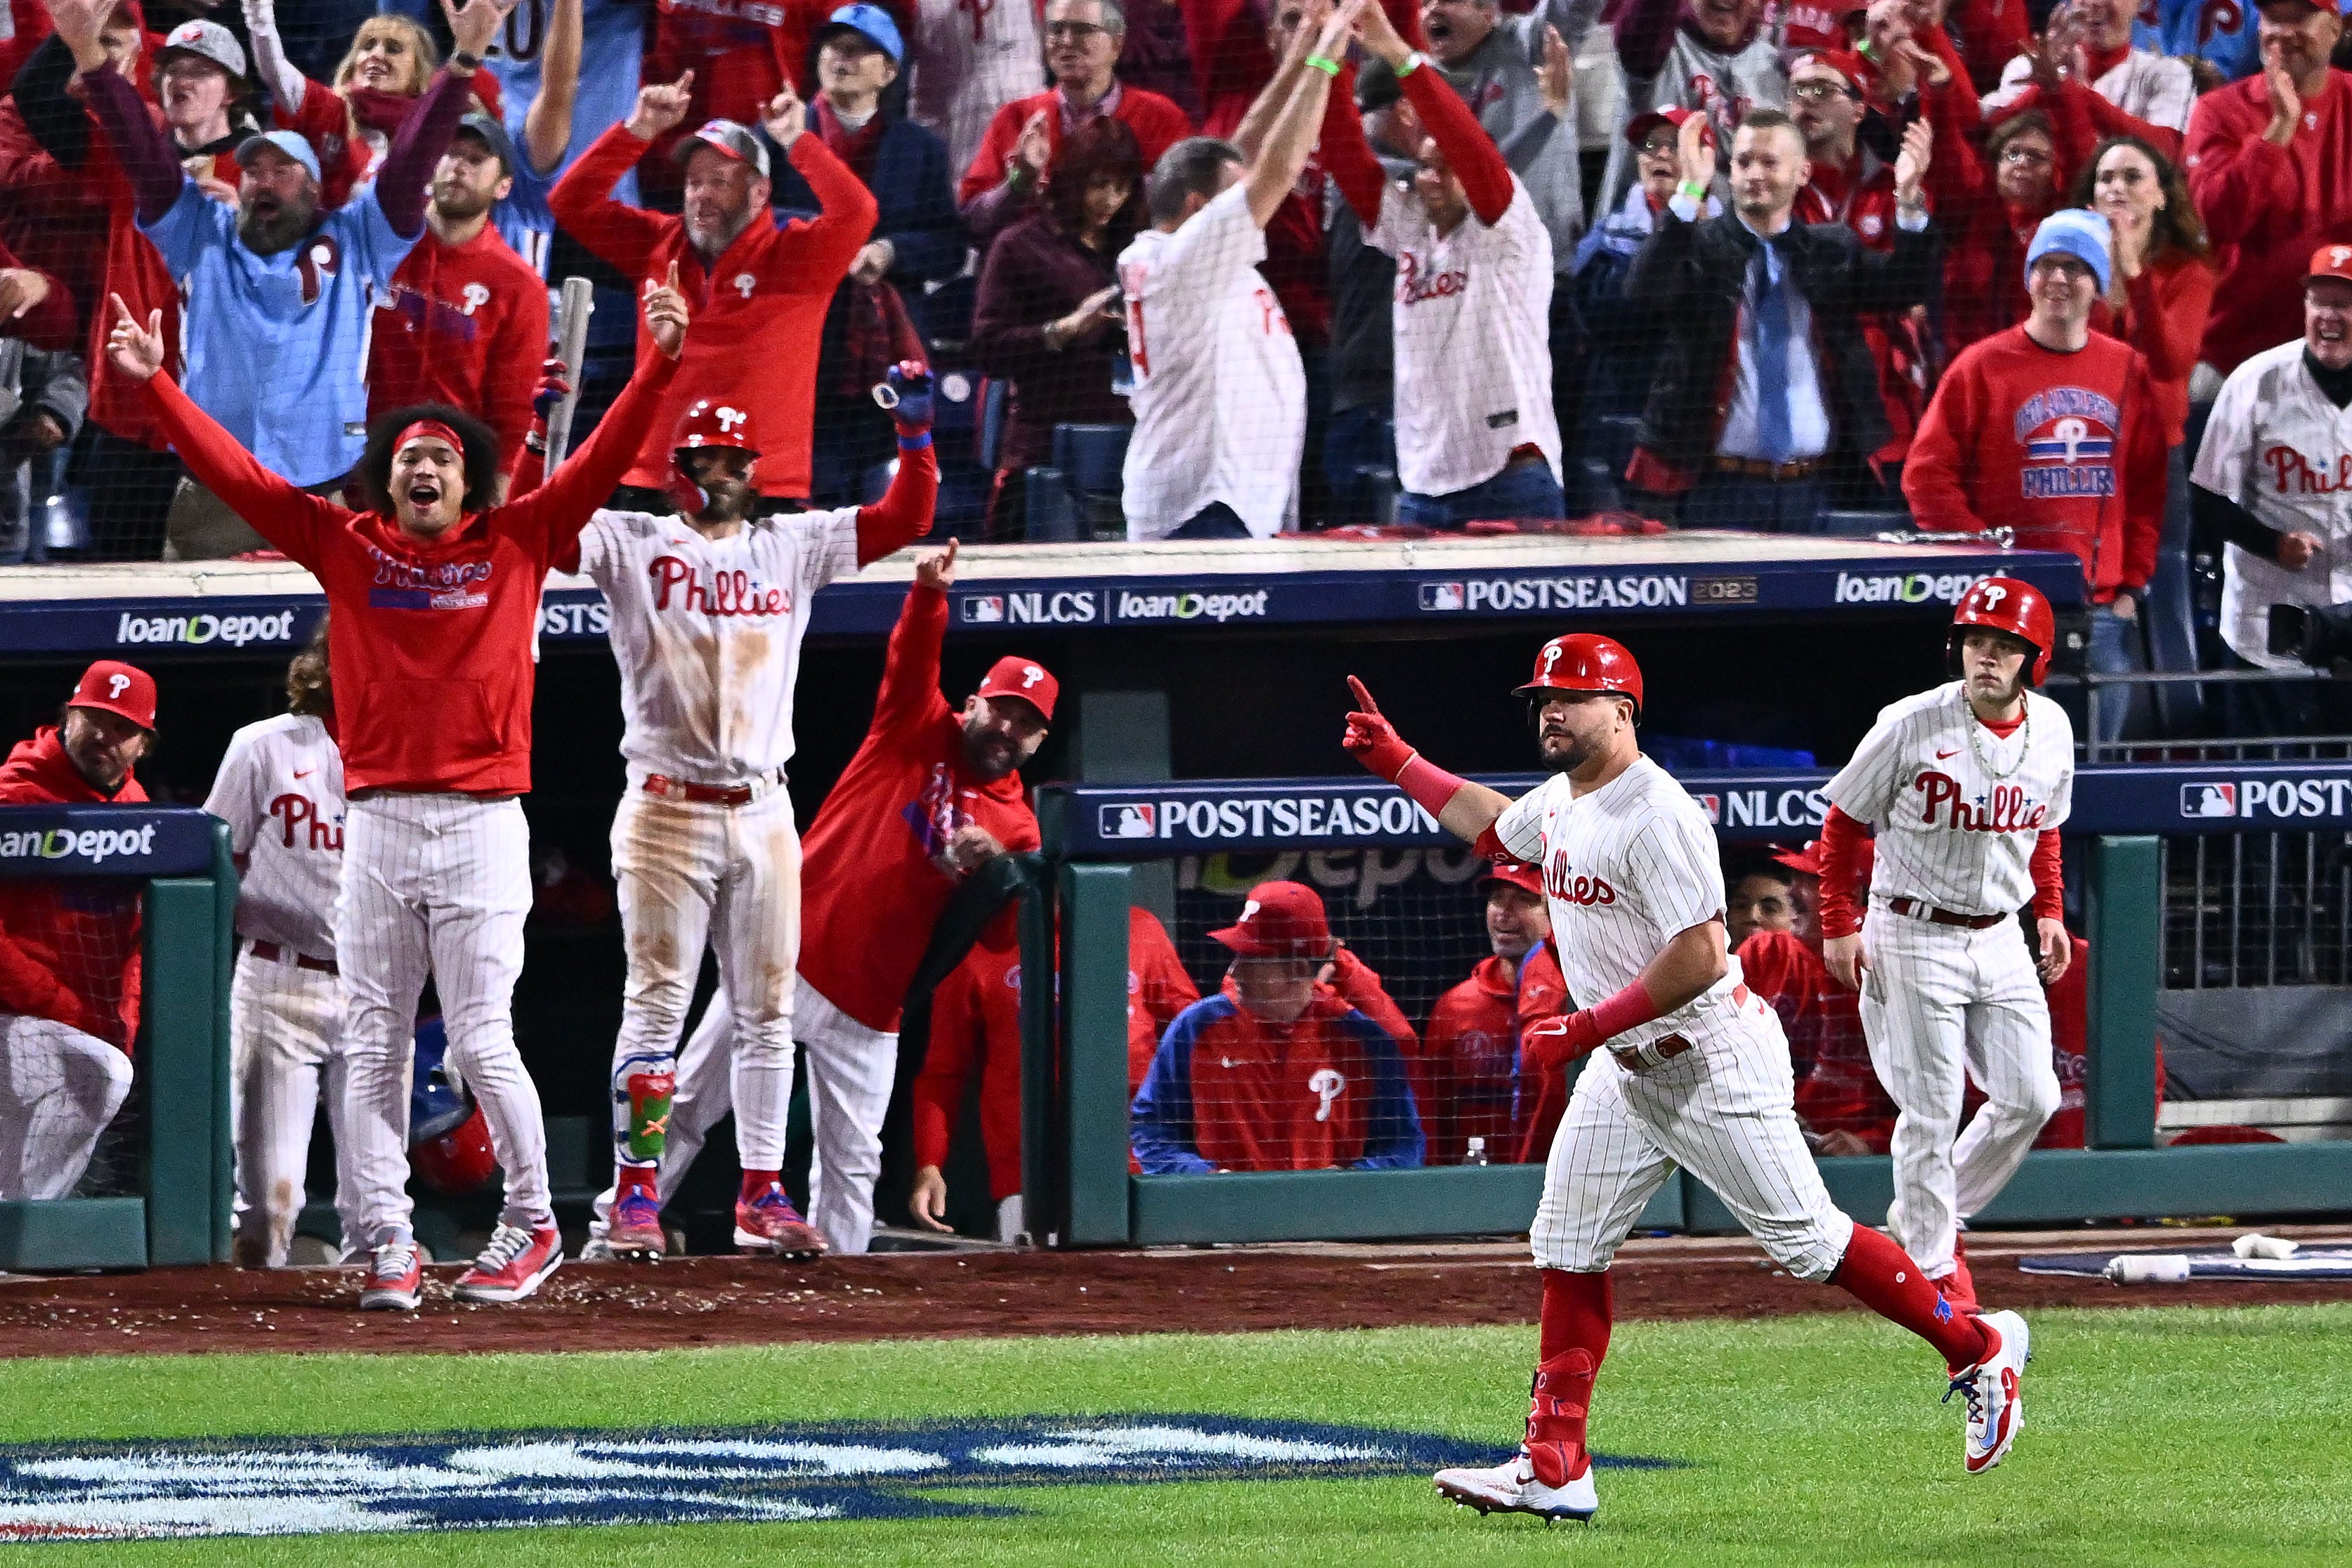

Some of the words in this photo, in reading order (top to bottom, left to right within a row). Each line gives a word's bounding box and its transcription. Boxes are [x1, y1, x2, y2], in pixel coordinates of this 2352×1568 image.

[1466, 575, 1687, 611] POSTSEASON
[1835, 568, 2008, 606] loanDep
[1985, 586, 2007, 611] P
[538, 603, 612, 635] STS
[1007, 591, 1096, 624] NLCS
[1118, 591, 1269, 623] loanDepot
[116, 609, 294, 647] loanDepot
[1543, 646, 1562, 673] P
[1727, 789, 1827, 828] NLCS
[2240, 778, 2352, 818] POST
[1158, 797, 1440, 839] POSTSEASON
[1308, 1069, 1345, 1122] P
